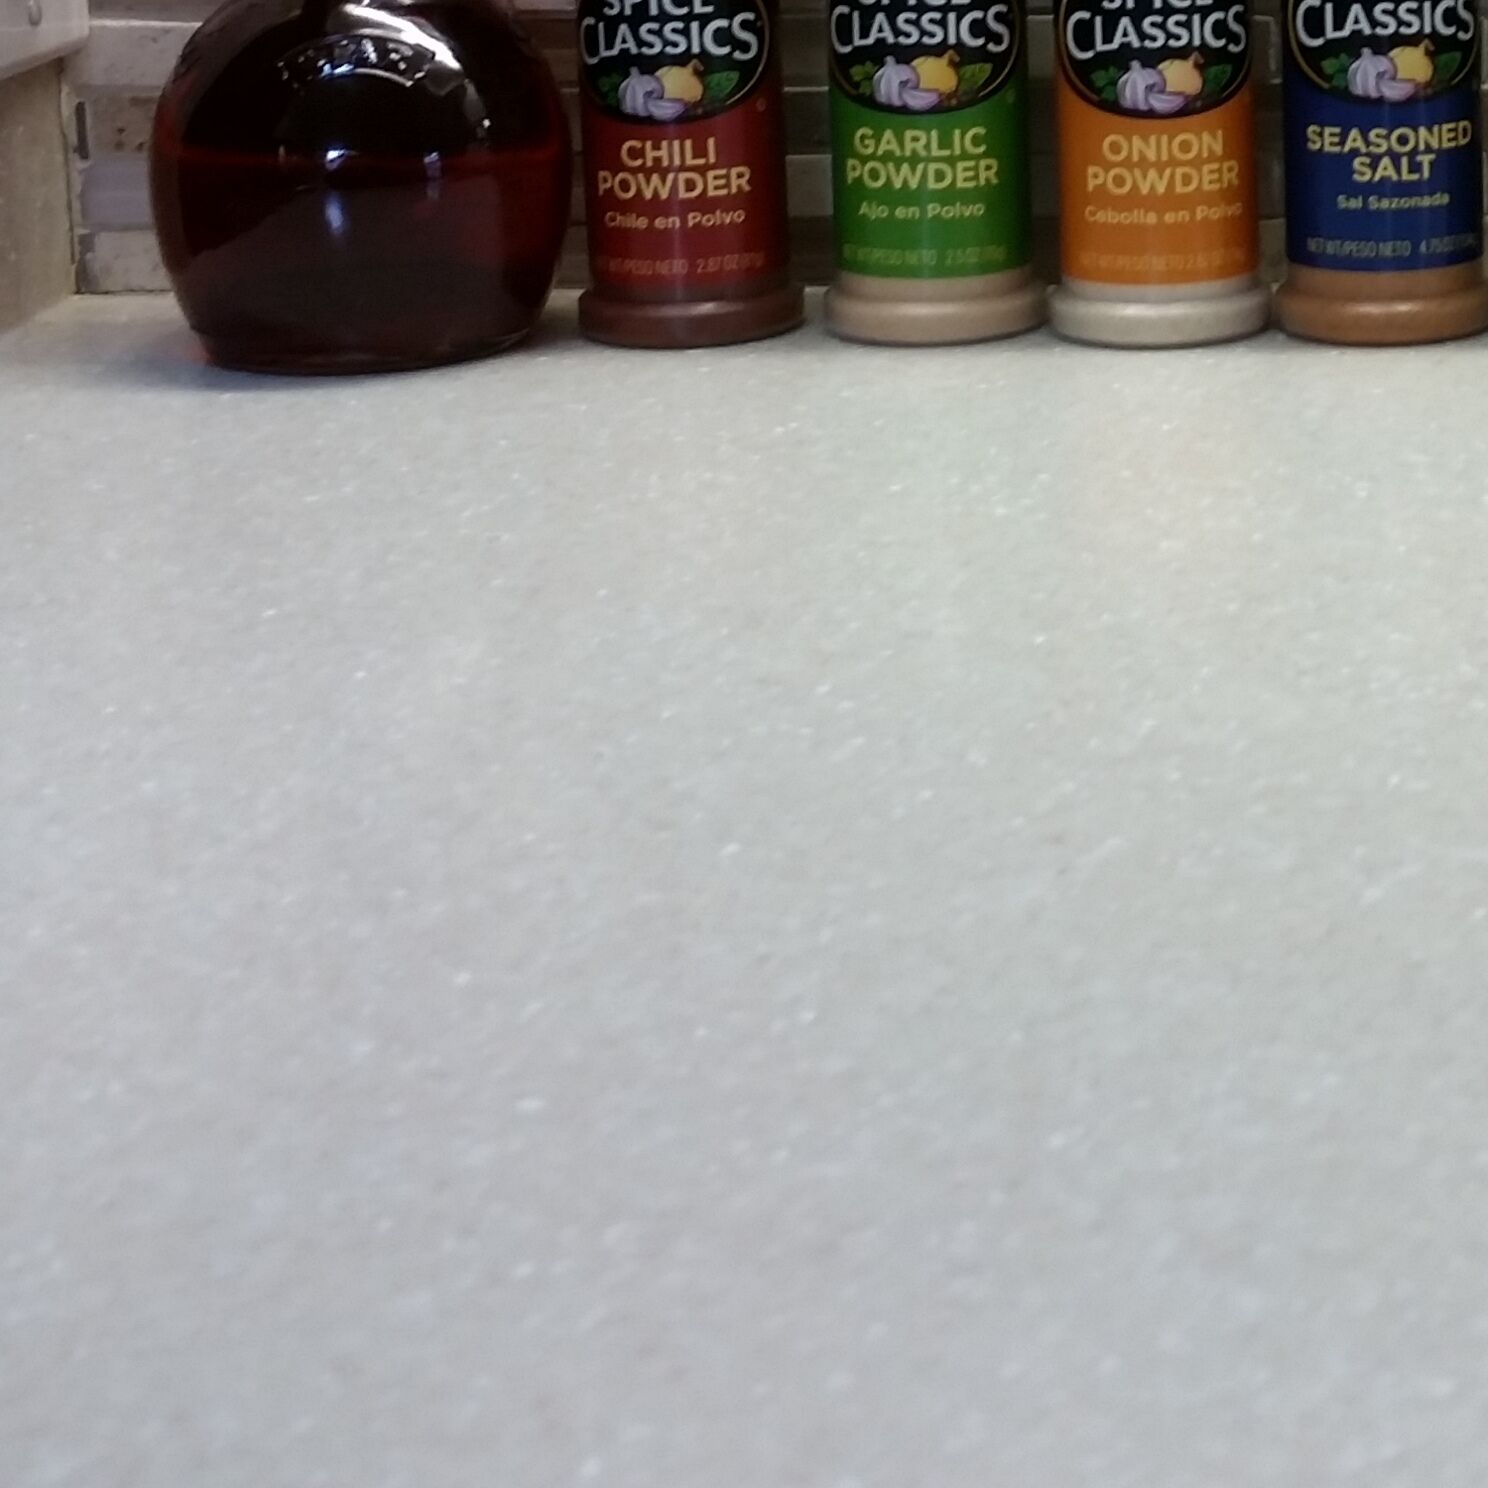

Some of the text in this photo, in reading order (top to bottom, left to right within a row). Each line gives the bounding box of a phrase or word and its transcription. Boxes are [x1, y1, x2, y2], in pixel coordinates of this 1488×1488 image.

[580, 12, 758, 65] CLASSICS
[830, 3, 1010, 54] CLASSICS
[1066, 4, 1246, 60] CLASSICS
[620, 137, 717, 168] CHILI
[854, 126, 987, 156] GARLIC
[1102, 130, 1223, 163] ONION
[1306, 120, 1472, 153] SEASONED
[598, 166, 752, 200] POWDER
[846, 159, 999, 190] POWDER
[1087, 160, 1239, 196] POWDER
[1352, 154, 1437, 183] SALT
[605, 209, 745, 229] Chile en Polvo
[858, 201, 984, 220] Ajo en Polvo
